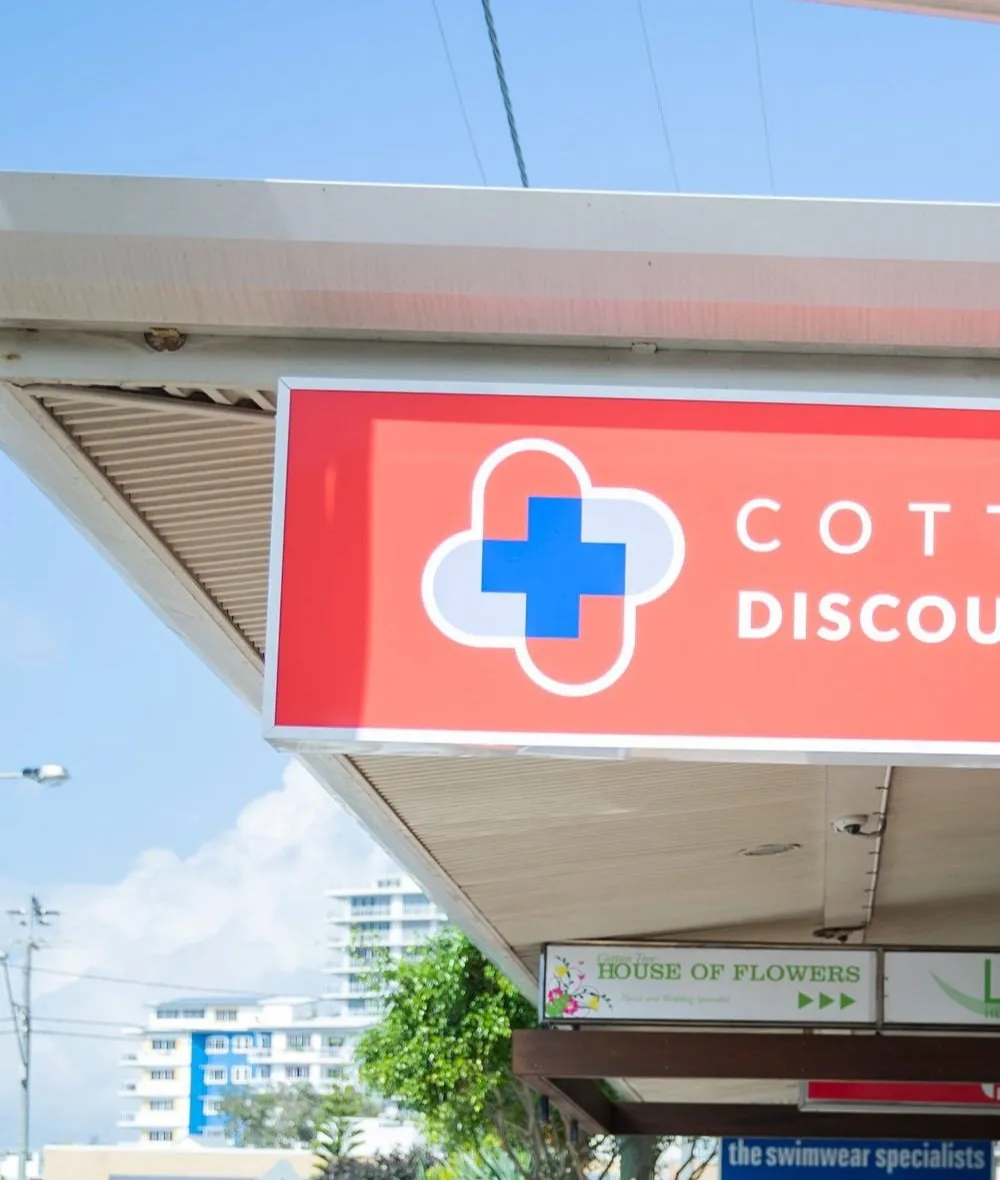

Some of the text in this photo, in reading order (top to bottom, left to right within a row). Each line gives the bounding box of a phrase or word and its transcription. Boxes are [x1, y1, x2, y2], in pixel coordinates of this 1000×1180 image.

[597, 962, 860, 983] HOUSE OF FLOWERS
[729, 1142, 985, 1174] the swimwear specialists
